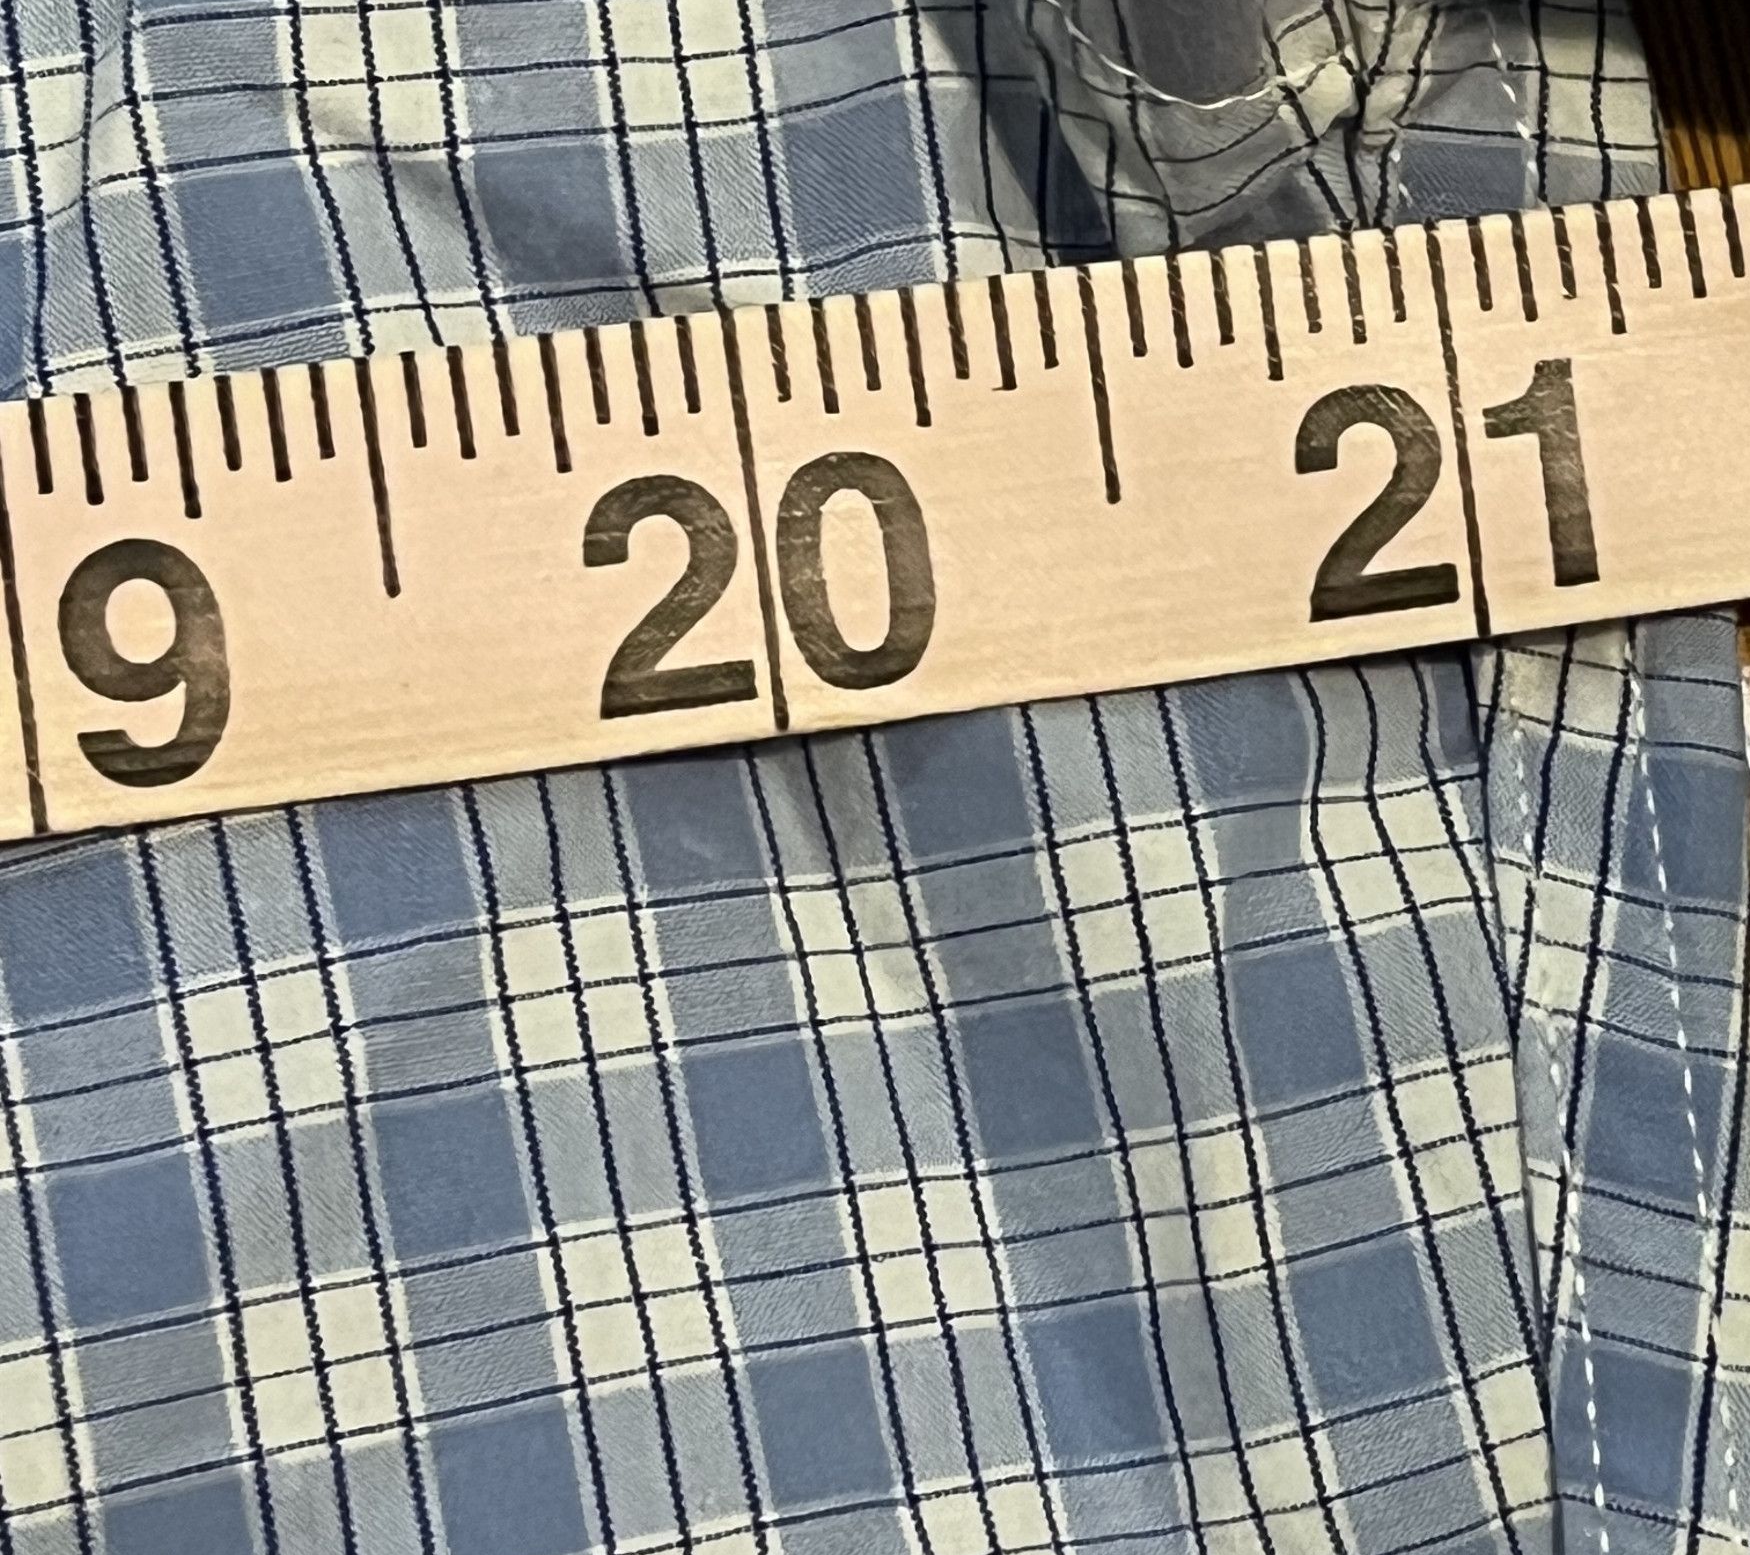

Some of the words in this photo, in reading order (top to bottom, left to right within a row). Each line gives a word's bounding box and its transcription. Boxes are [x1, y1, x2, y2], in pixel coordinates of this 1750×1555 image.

[58, 538, 229, 787] 9
[583, 451, 936, 720] 20
[1295, 357, 1599, 622] 21
